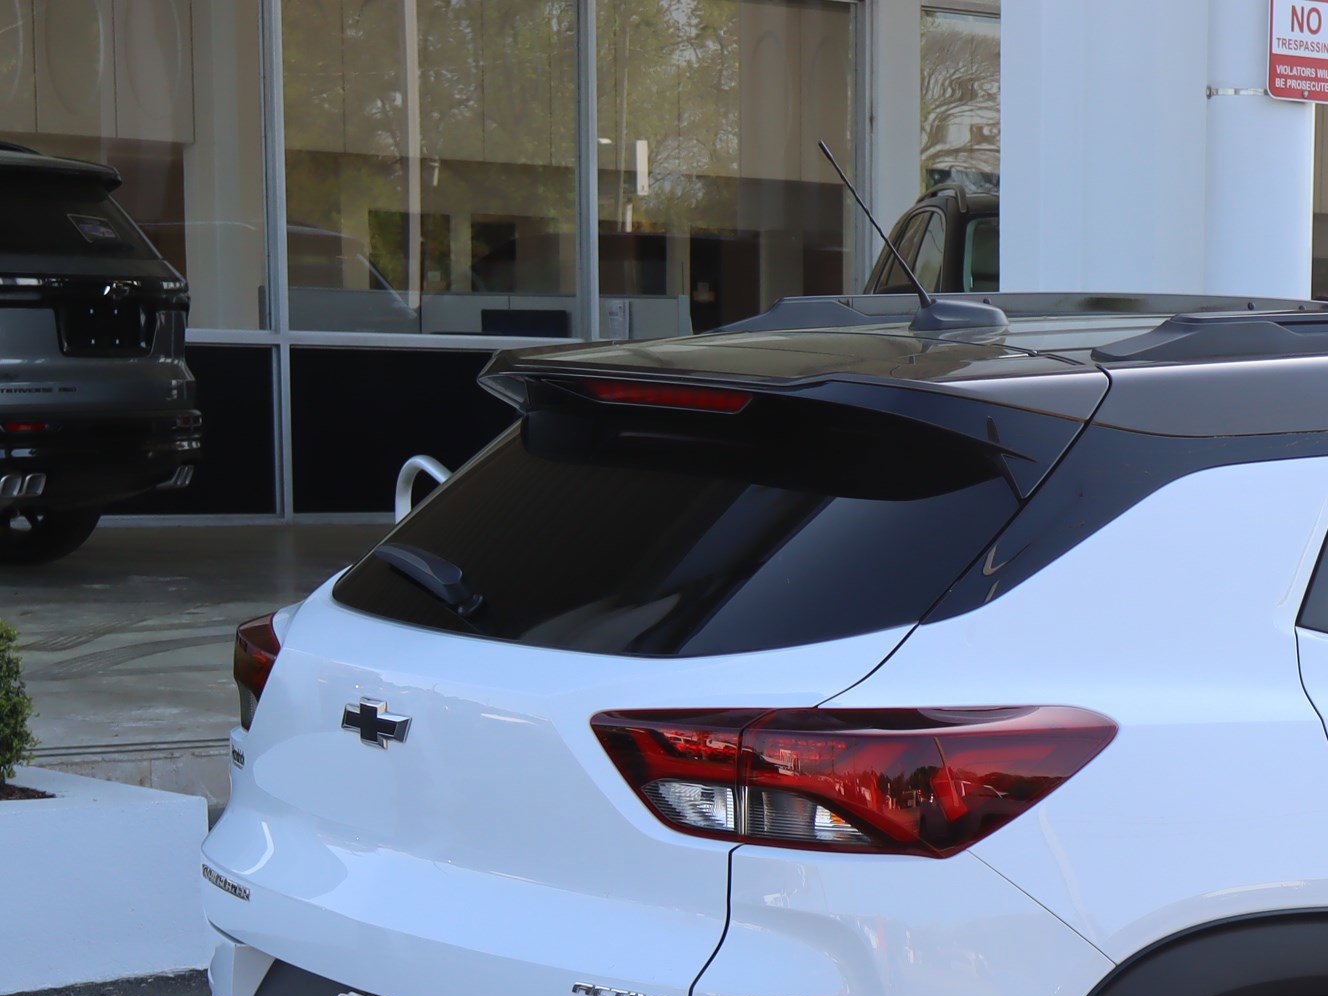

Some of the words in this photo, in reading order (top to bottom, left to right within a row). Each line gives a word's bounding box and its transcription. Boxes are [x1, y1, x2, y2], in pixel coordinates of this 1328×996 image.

[1291, 5, 1322, 35] NO
[1276, 65, 1315, 78] VIOLATORS
[1275, 78, 1286, 88] BE
